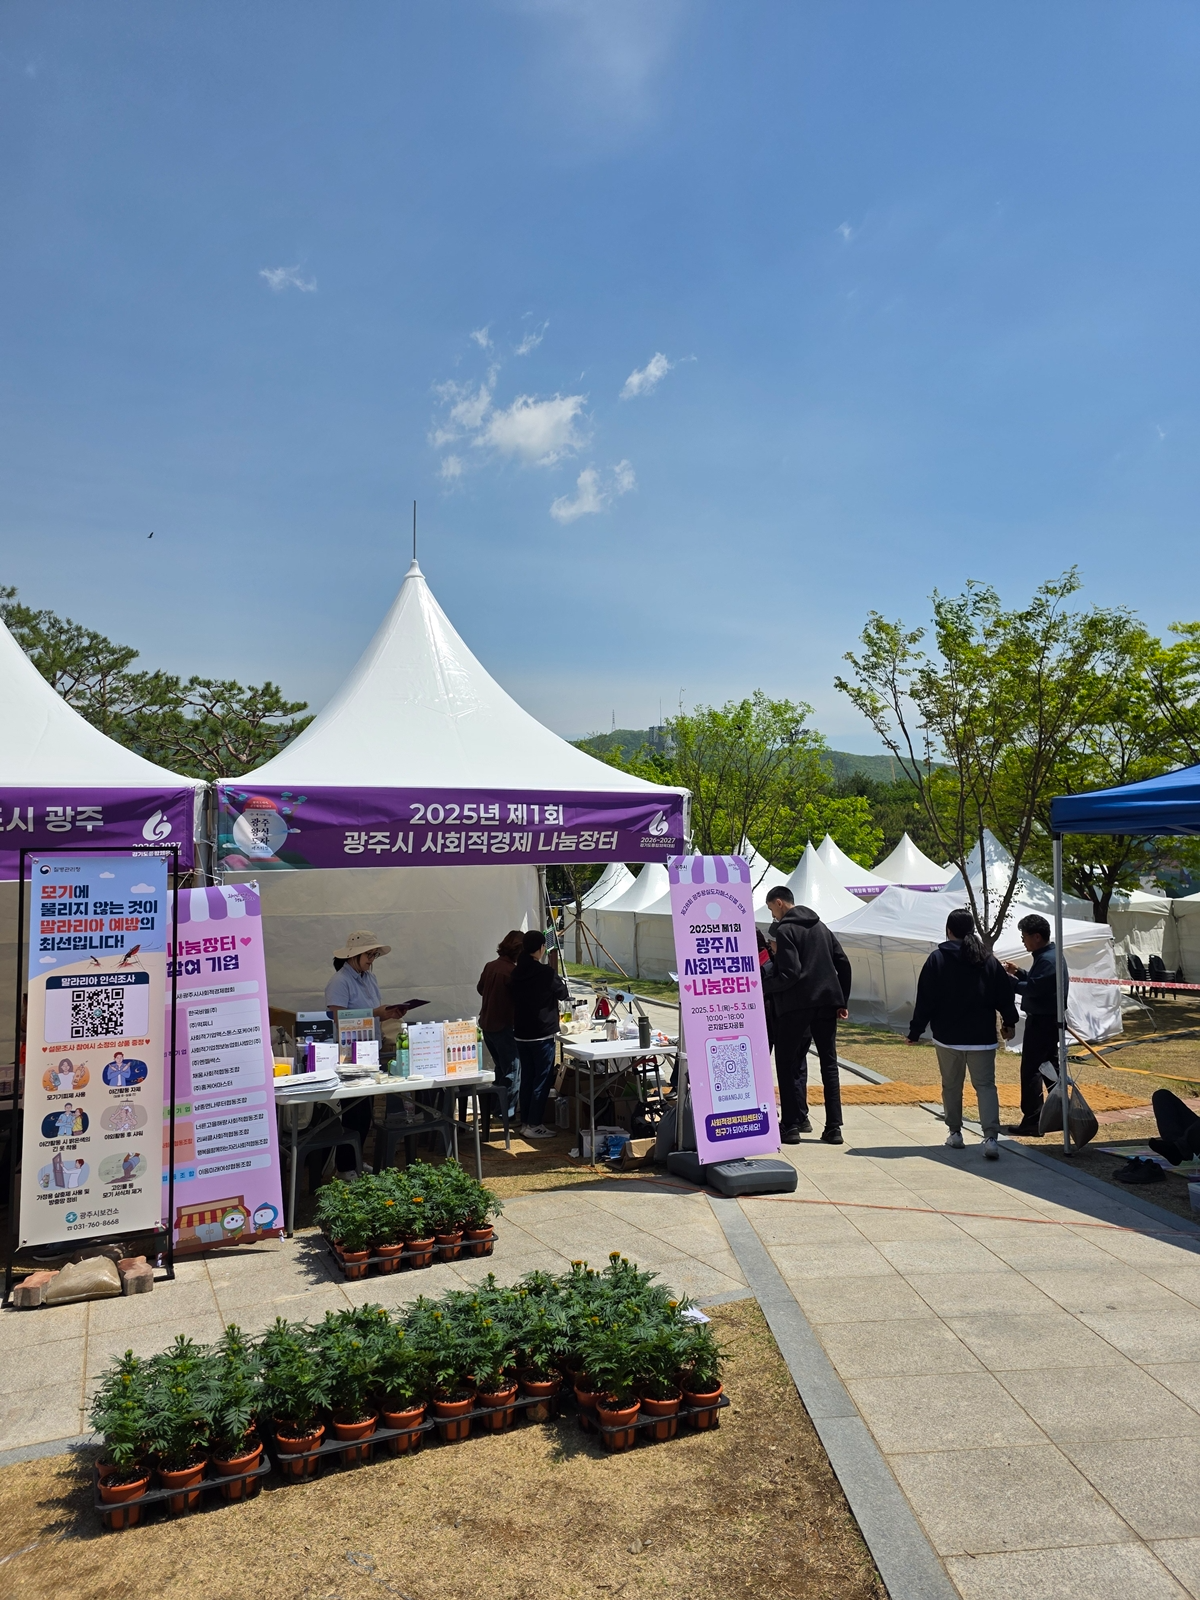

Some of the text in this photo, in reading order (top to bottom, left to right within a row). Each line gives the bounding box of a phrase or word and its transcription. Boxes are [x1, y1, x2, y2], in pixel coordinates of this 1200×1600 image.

[45, 806, 104, 832] 광주
[409, 803, 564, 826] 2025년 제1회
[343, 830, 619, 854] 광주시 사회적경제 나눔장터
[41, 885, 90, 899] 모기에
[40, 900, 158, 917] 물리지 않는 것이
[40, 917, 155, 934] 말라리아 예방의
[689, 923, 742, 934] 2025년 제1회
[39, 935, 125, 952] 최선입니다!
[167, 935, 237, 958] 나눔장터
[695, 936, 739, 955] 광주시
[205, 954, 240, 973] 기업
[684, 955, 755, 976] 사회적경제
[61, 975, 136, 987] 말라리아 인식조사
[692, 976, 751, 996] 나눔장터
[707, 1021, 745, 1032] 곤지암도자공원
[79, 1208, 120, 1220] 광주시보건소
[73, 1218, 120, 1231] 031-760-8668
